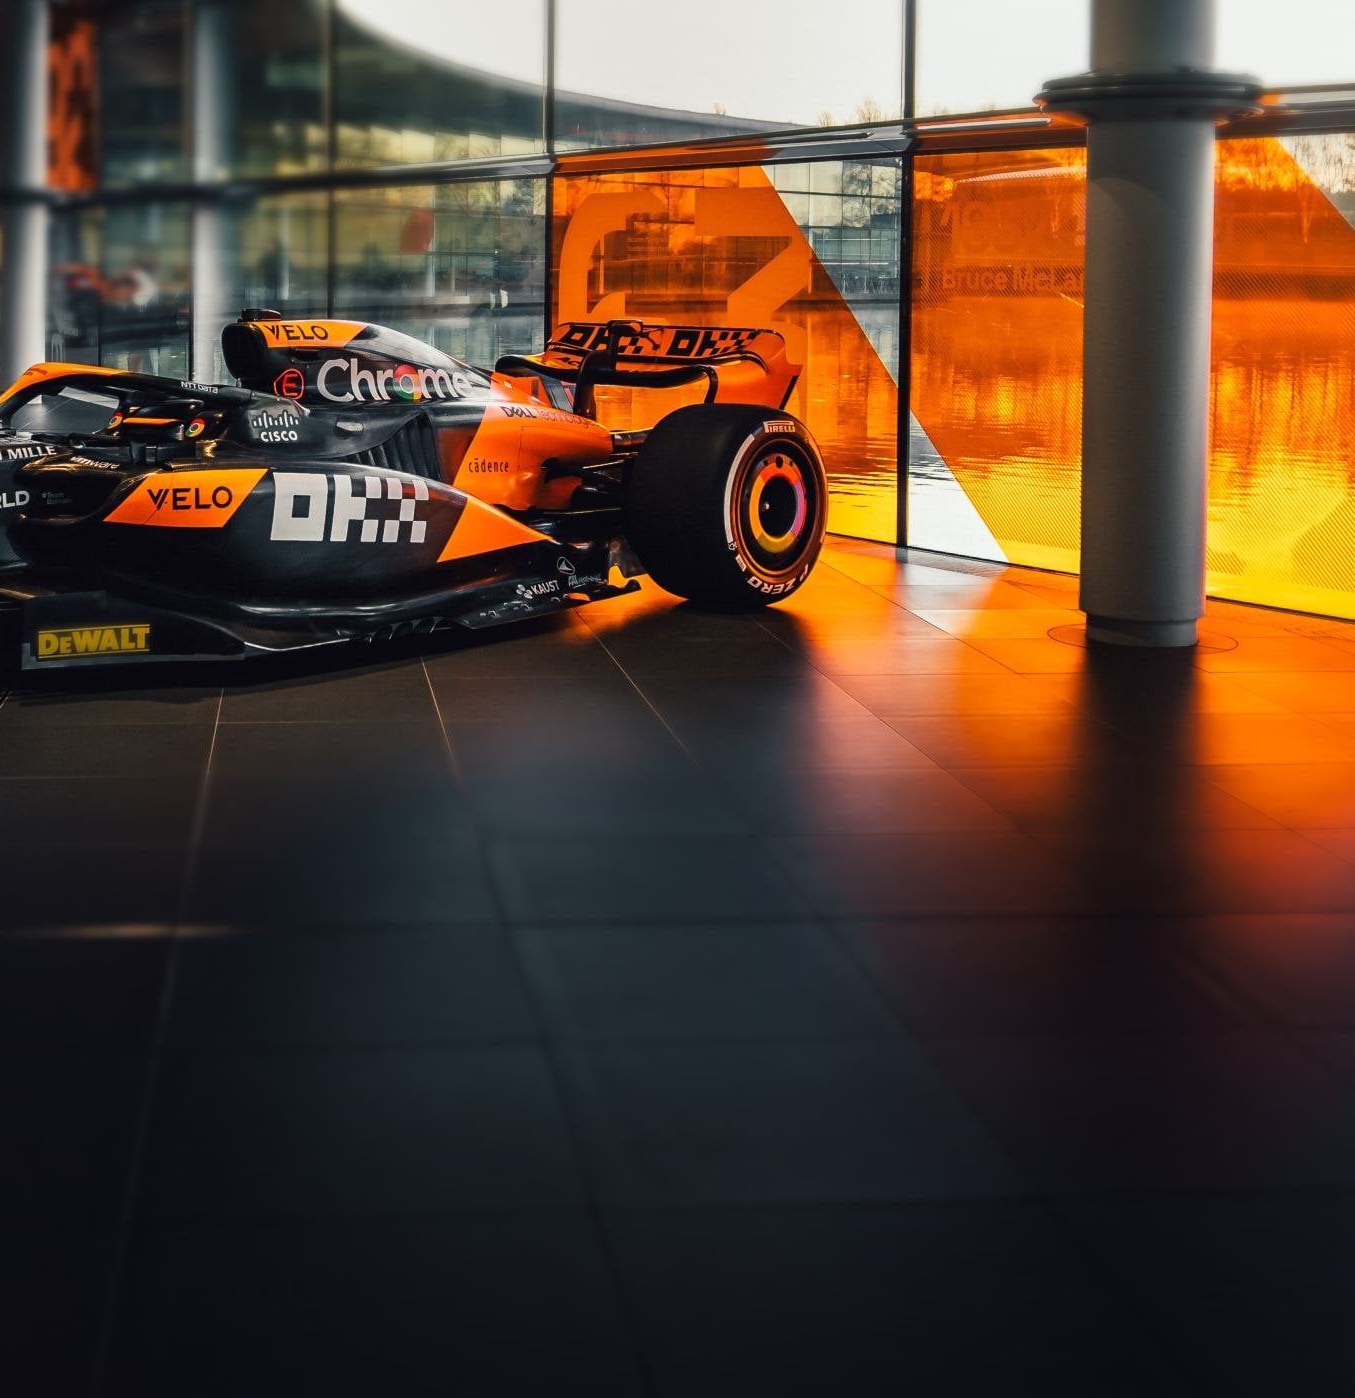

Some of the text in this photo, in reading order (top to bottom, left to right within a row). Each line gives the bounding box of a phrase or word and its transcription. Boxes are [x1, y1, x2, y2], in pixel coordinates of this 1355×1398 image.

[943, 266, 1084, 290] Bruce McLar
[264, 324, 329, 341] VELO
[317, 358, 475, 403] Chrome
[763, 420, 796, 433] PIRELLI
[260, 430, 298, 442] CISCO
[8, 445, 57, 460] MILLE
[147, 485, 233, 511] VELO
[270, 472, 429, 543] OKX
[531, 580, 560, 595] KAUST
[747, 576, 797, 595] ZERO
